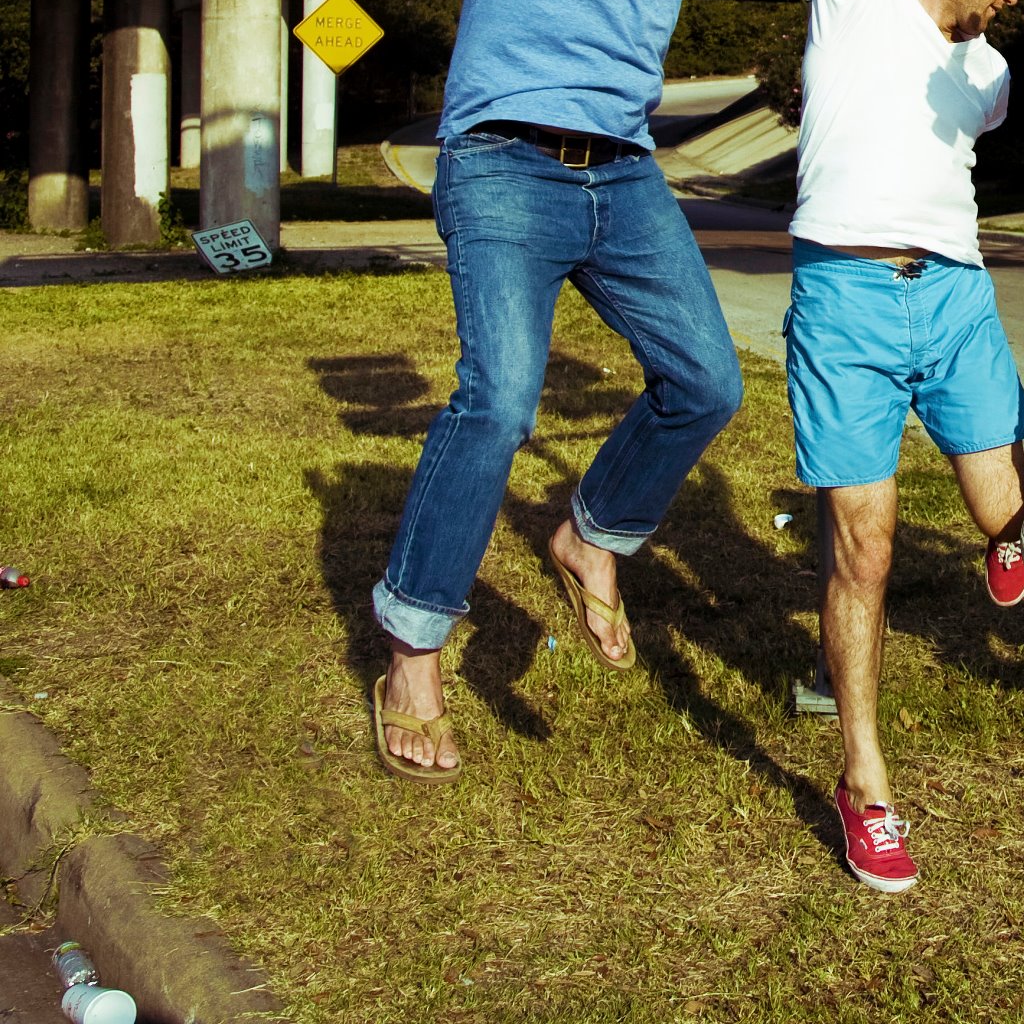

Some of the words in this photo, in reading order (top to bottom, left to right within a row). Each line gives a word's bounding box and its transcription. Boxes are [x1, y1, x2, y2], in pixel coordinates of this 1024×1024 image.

[315, 16, 362, 30] MERGE
[314, 36, 363, 49] AHEAD
[199, 225, 251, 246] SPEED
[210, 235, 251, 253] LIMIT
[213, 244, 268, 270] 35
